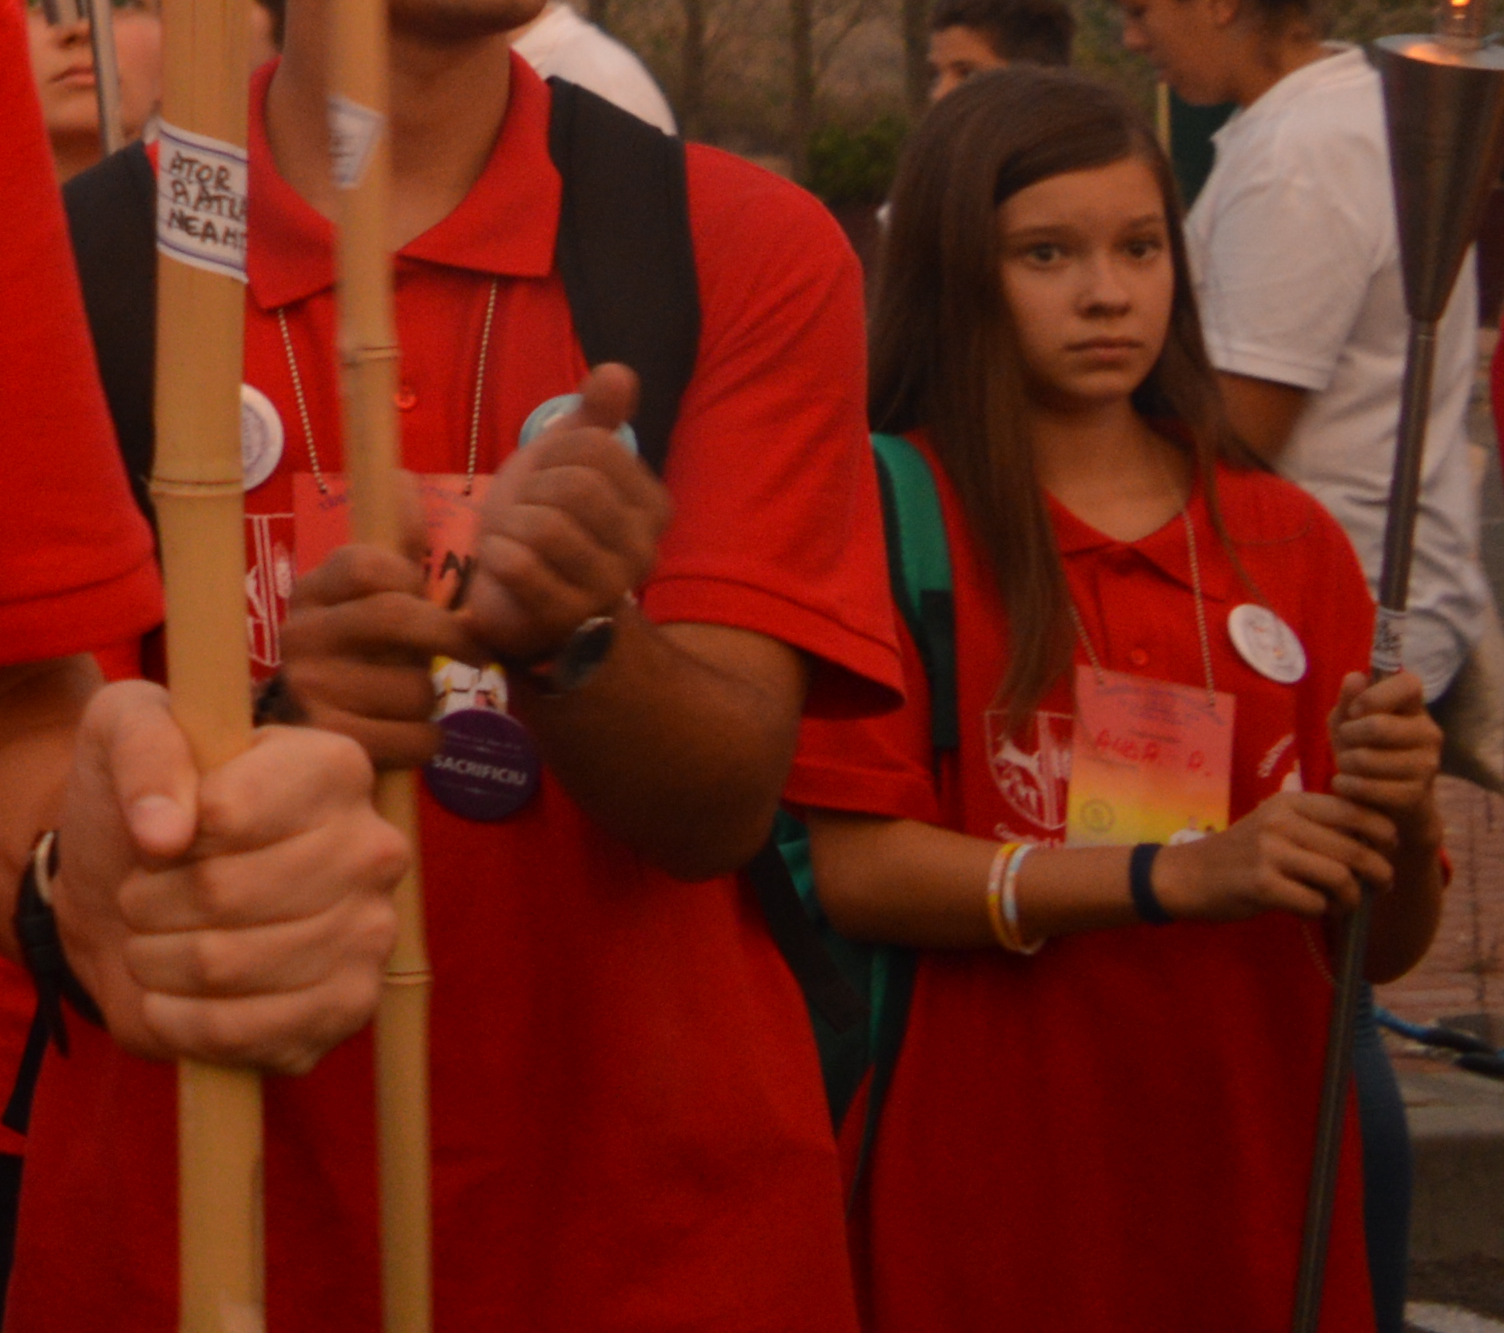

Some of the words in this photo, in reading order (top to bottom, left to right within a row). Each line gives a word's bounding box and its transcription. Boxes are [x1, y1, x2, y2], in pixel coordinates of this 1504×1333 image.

[170, 151, 231, 192] ATOR
[168, 207, 247, 249] NEAM
[432, 752, 530, 786] SACRIFICIU
